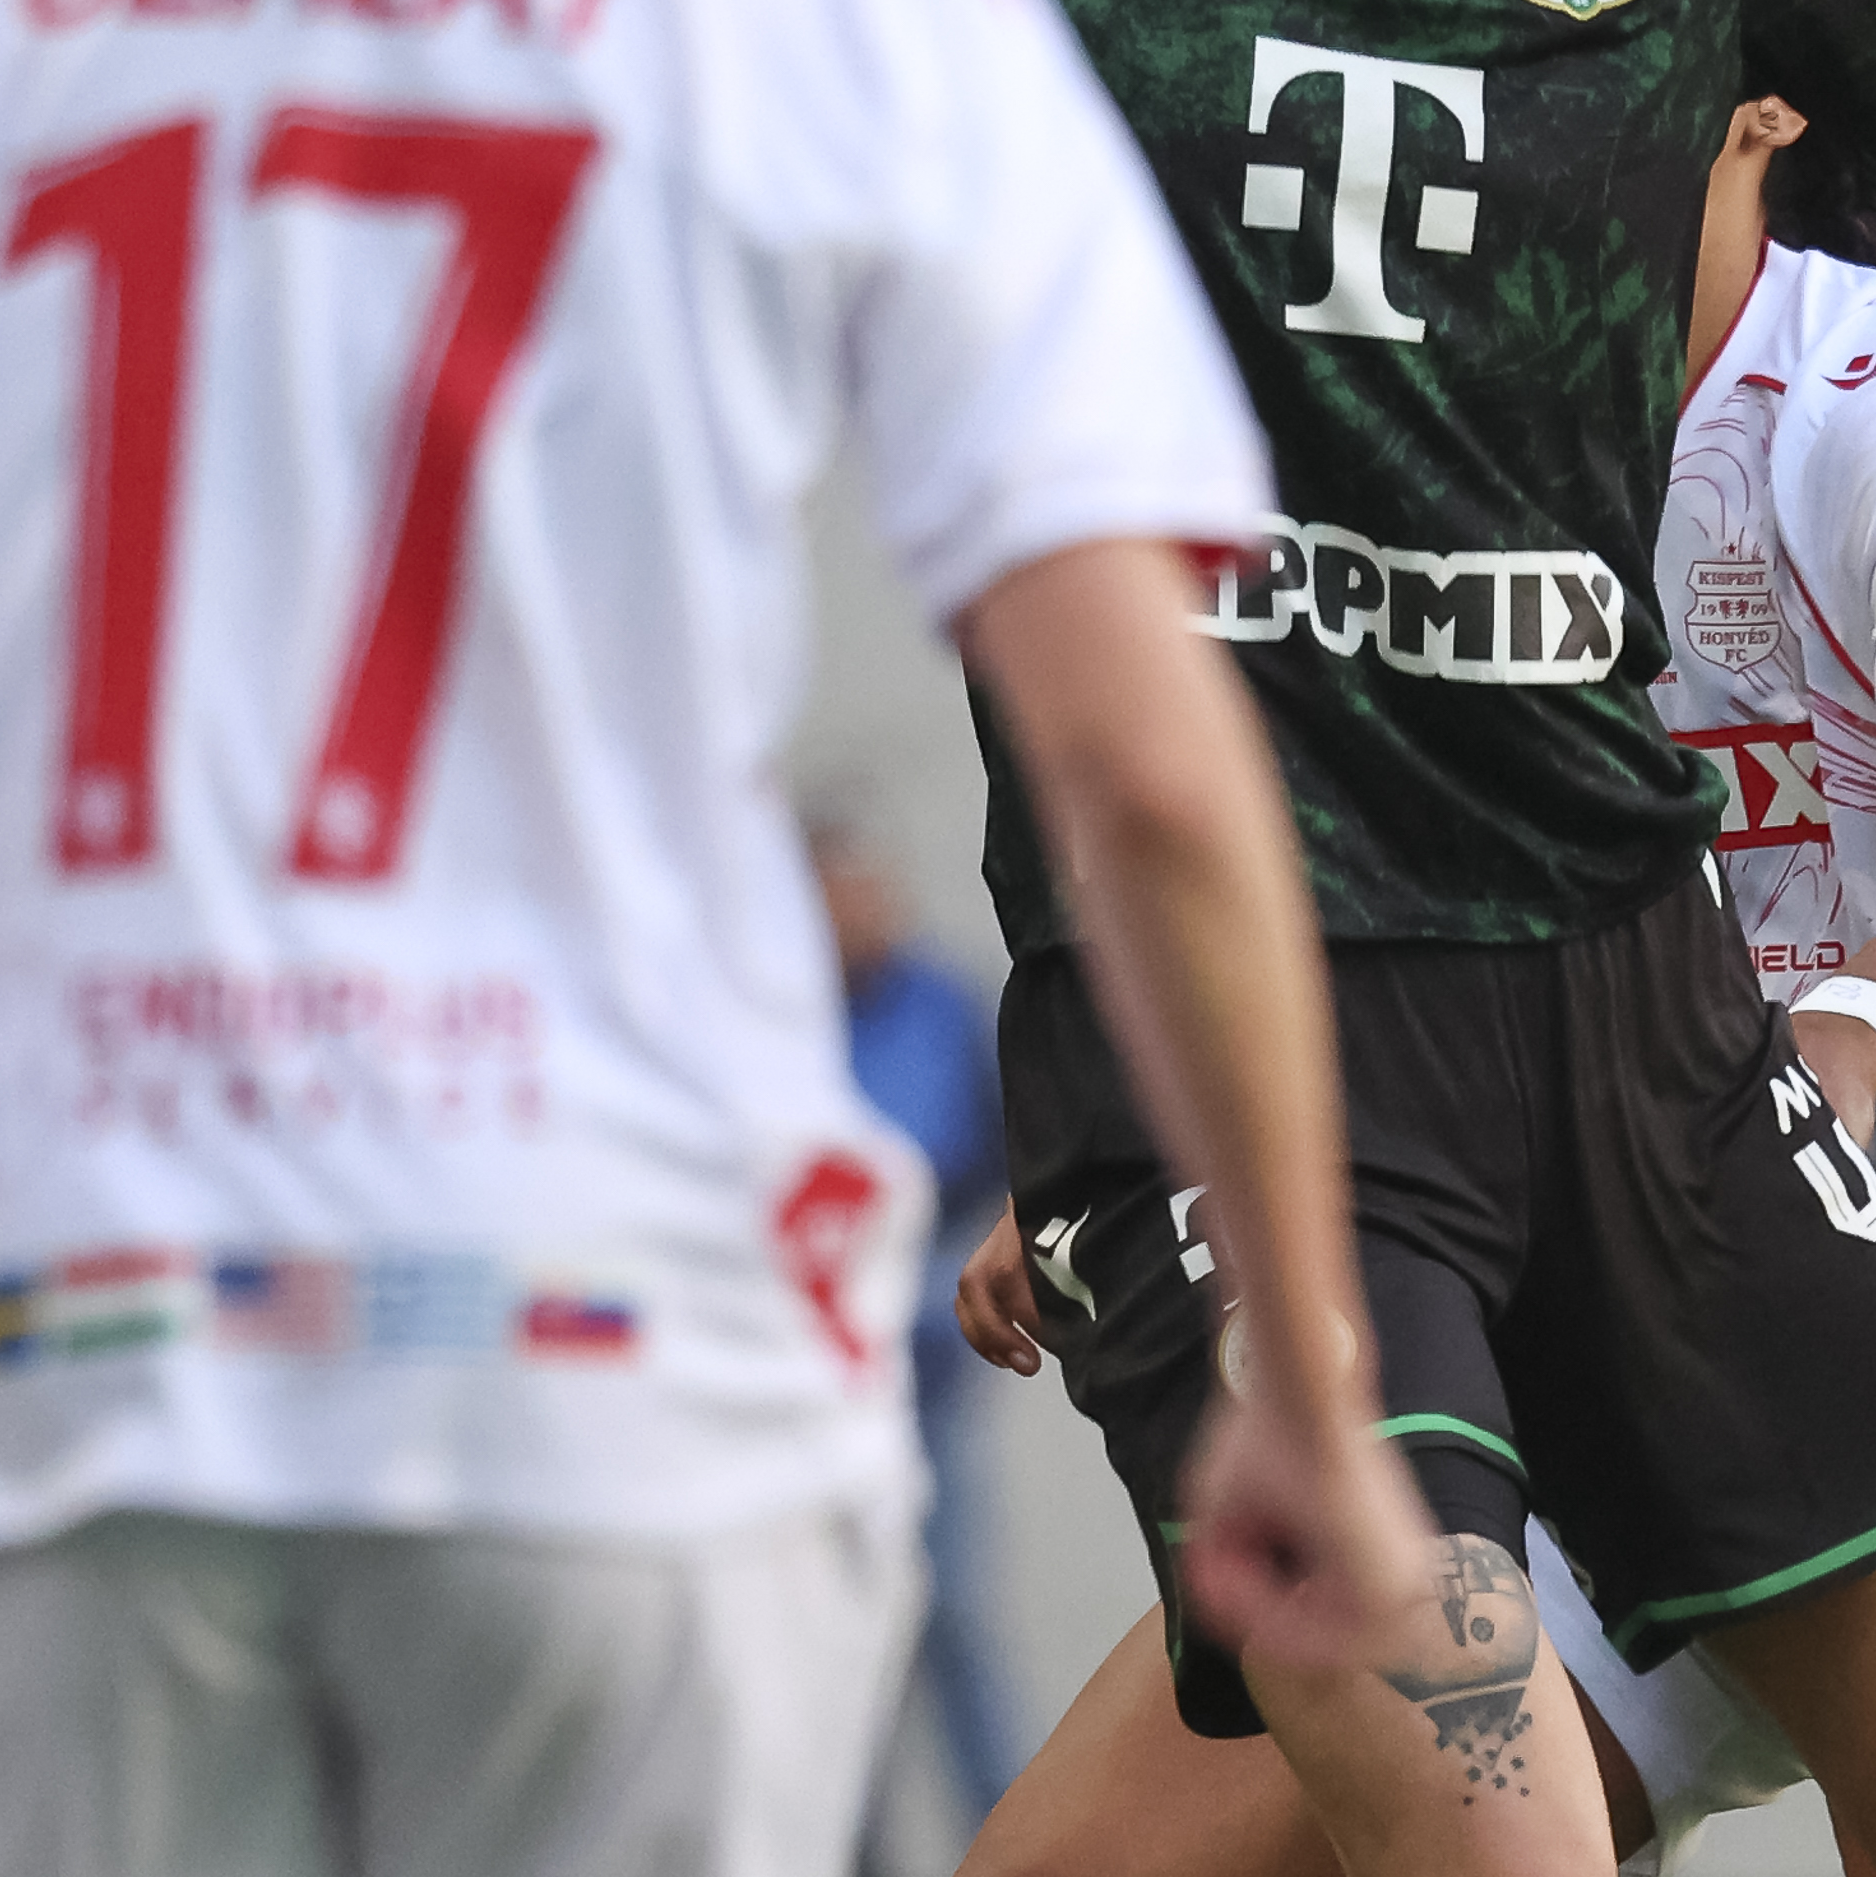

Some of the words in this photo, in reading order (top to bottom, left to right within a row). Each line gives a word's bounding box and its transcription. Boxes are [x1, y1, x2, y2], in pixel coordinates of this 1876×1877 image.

[0, 106, 605, 886] 17
[1700, 603, 1717, 617] 19
[1699, 626, 1771, 646] HONVÉD
[1724, 648, 1748, 664] FC
[1750, 940, 1846, 974] IELD
